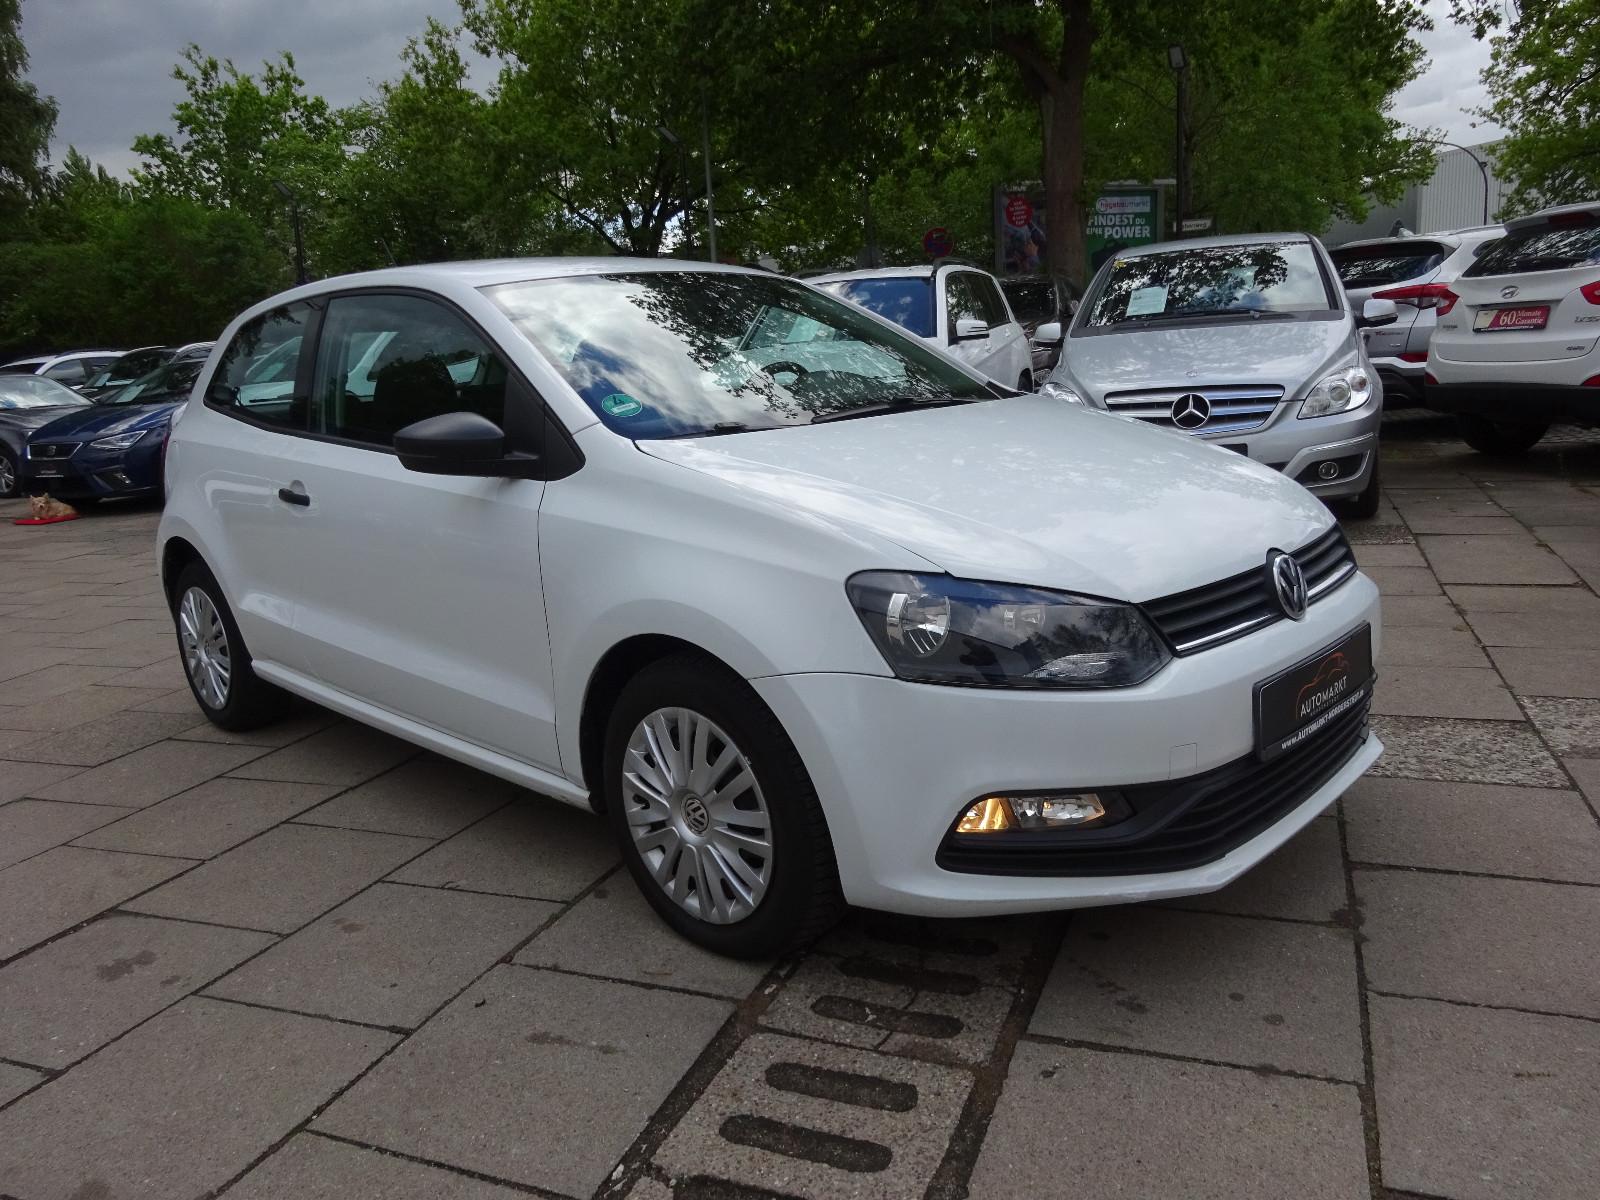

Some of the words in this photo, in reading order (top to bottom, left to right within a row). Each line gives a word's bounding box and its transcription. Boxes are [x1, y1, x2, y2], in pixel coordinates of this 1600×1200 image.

[1135, 217, 1146, 225] DU
[1104, 226, 1151, 239] POWER
[1499, 311, 1516, 326] 60
[1515, 317, 1544, 325] Garantie
[1300, 676, 1347, 717] AUTOMARKT
